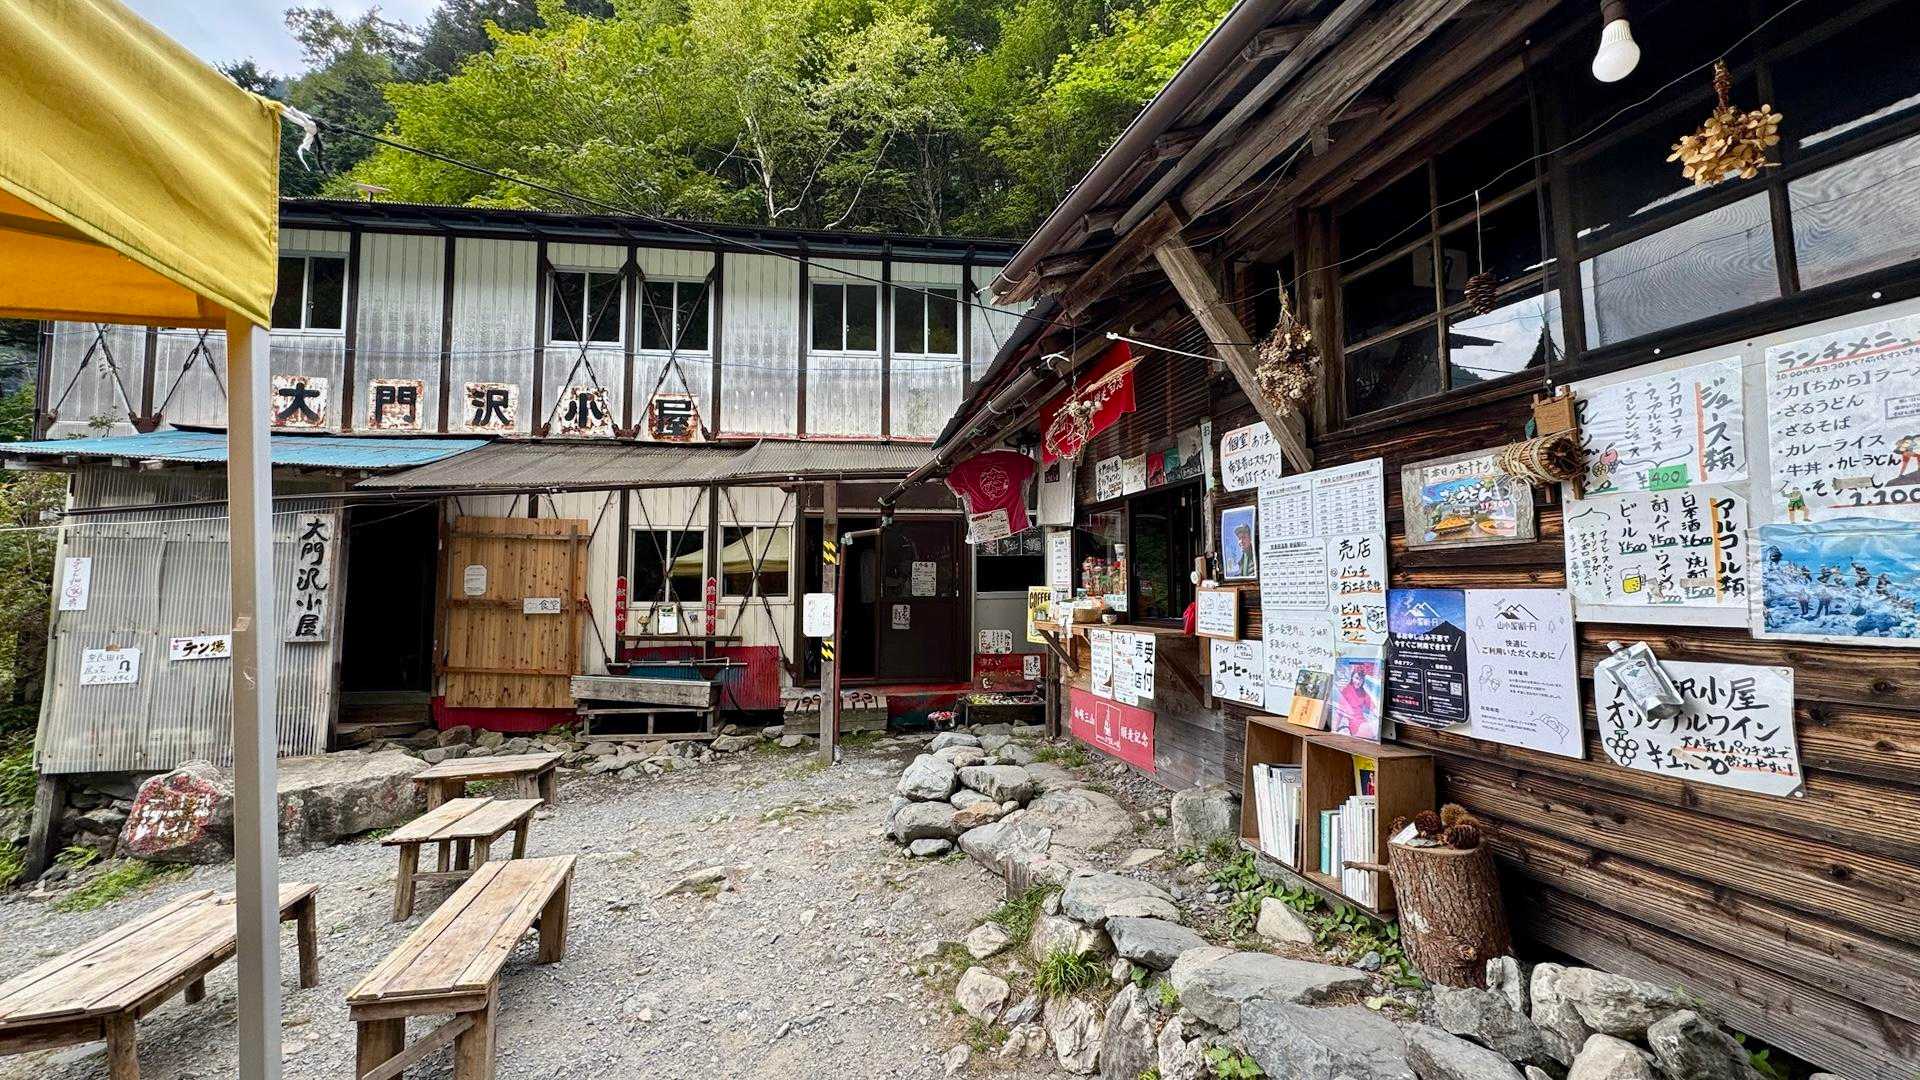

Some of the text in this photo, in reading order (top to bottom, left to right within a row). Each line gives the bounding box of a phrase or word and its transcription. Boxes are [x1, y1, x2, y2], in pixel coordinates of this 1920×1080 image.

[1778, 330, 1920, 369] ランチメニュ
[277, 382, 691, 436] 大門沢小屋
[1667, 381, 1684, 438] コカコーラ
[1785, 394, 1864, 417] ざるうどん
[1700, 377, 1736, 472] ジュース類
[1785, 416, 1850, 437] ざるそば
[1227, 432, 1248, 451] 個室
[1786, 434, 1885, 457] カレーライス
[1787, 462, 1821, 477] 牛丼
[1620, 503, 1639, 538] ビール
[1651, 498, 1670, 530] 酎ハイ
[1681, 494, 1701, 533] 日本酒
[1339, 537, 1372, 561] 売店
[1618, 541, 1647, 553] ¥500
[1649, 533, 1678, 546] ¥500
[1679, 534, 1713, 547] ¥600
[1712, 497, 1746, 597] アルコール類
[296, 517, 328, 638] 大門沢小屋
[1685, 556, 1708, 579] 焼酎
[1684, 587, 1715, 598] ¥500
[1482, 646, 1557, 660] ご利用いただくために
[1505, 639, 1529, 648] 快適に
[1220, 660, 1247, 677] コーヒー
